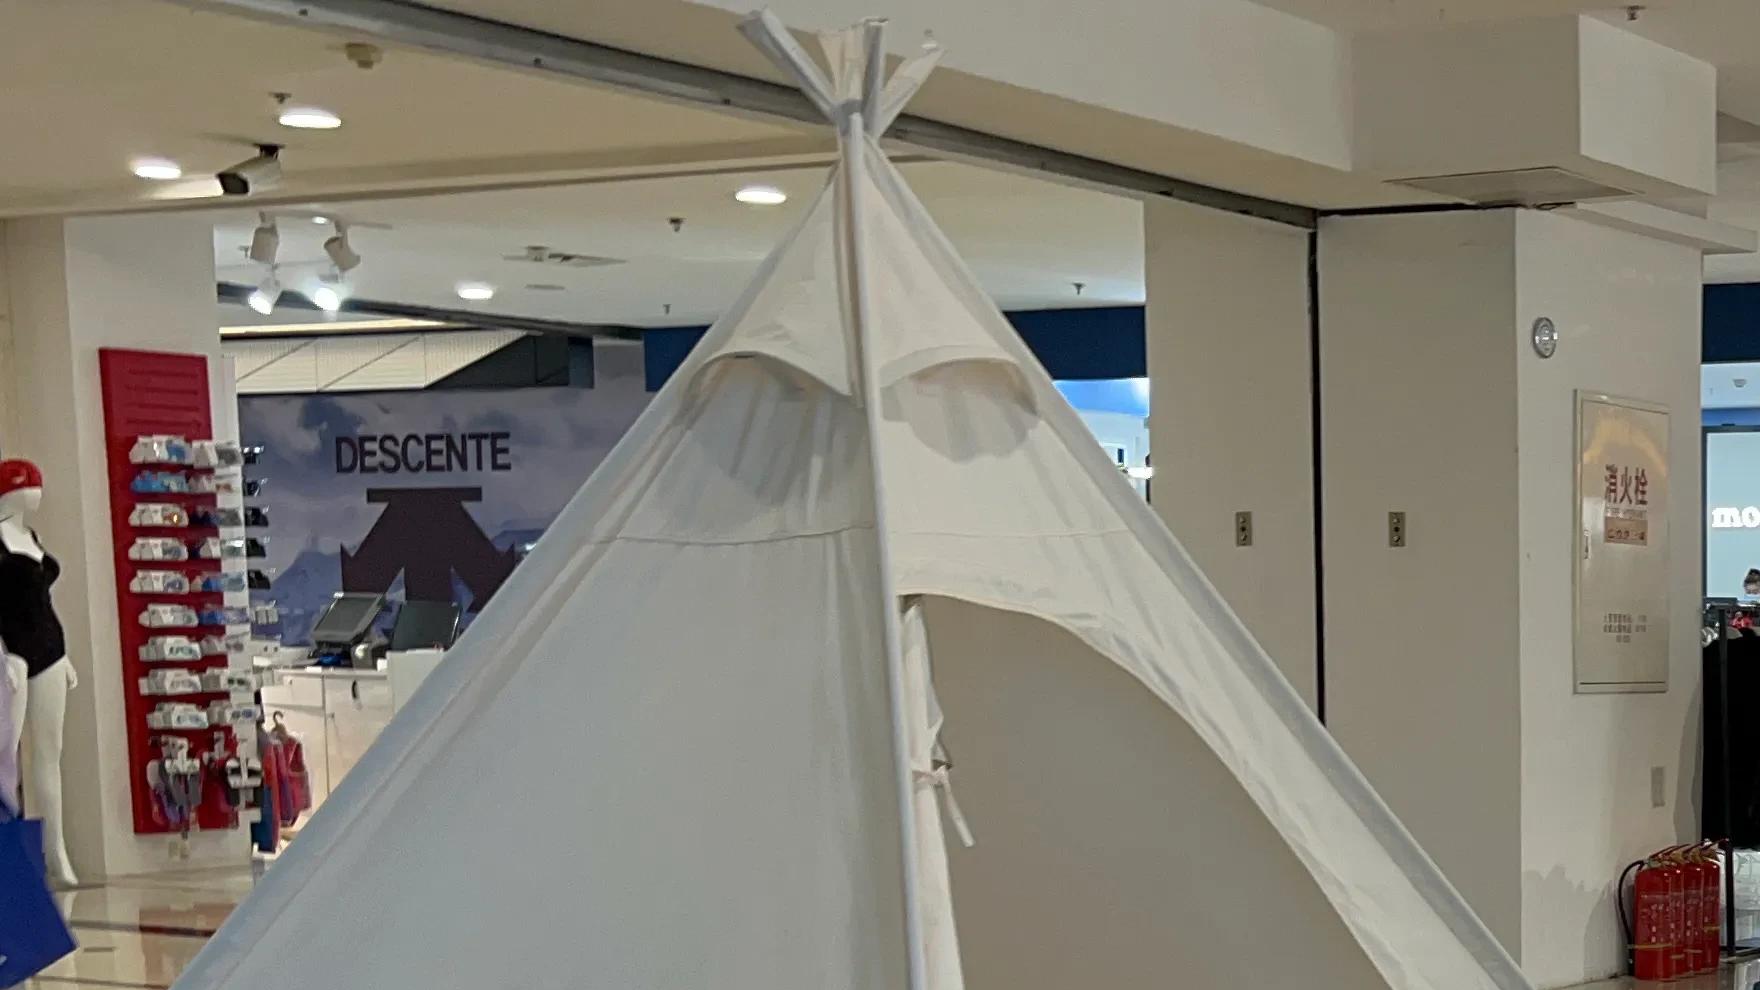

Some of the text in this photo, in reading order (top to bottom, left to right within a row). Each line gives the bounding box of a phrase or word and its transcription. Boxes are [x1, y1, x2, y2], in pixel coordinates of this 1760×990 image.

[335, 432, 512, 474] DESCENTE
[1604, 464, 1648, 505] 消火栓
